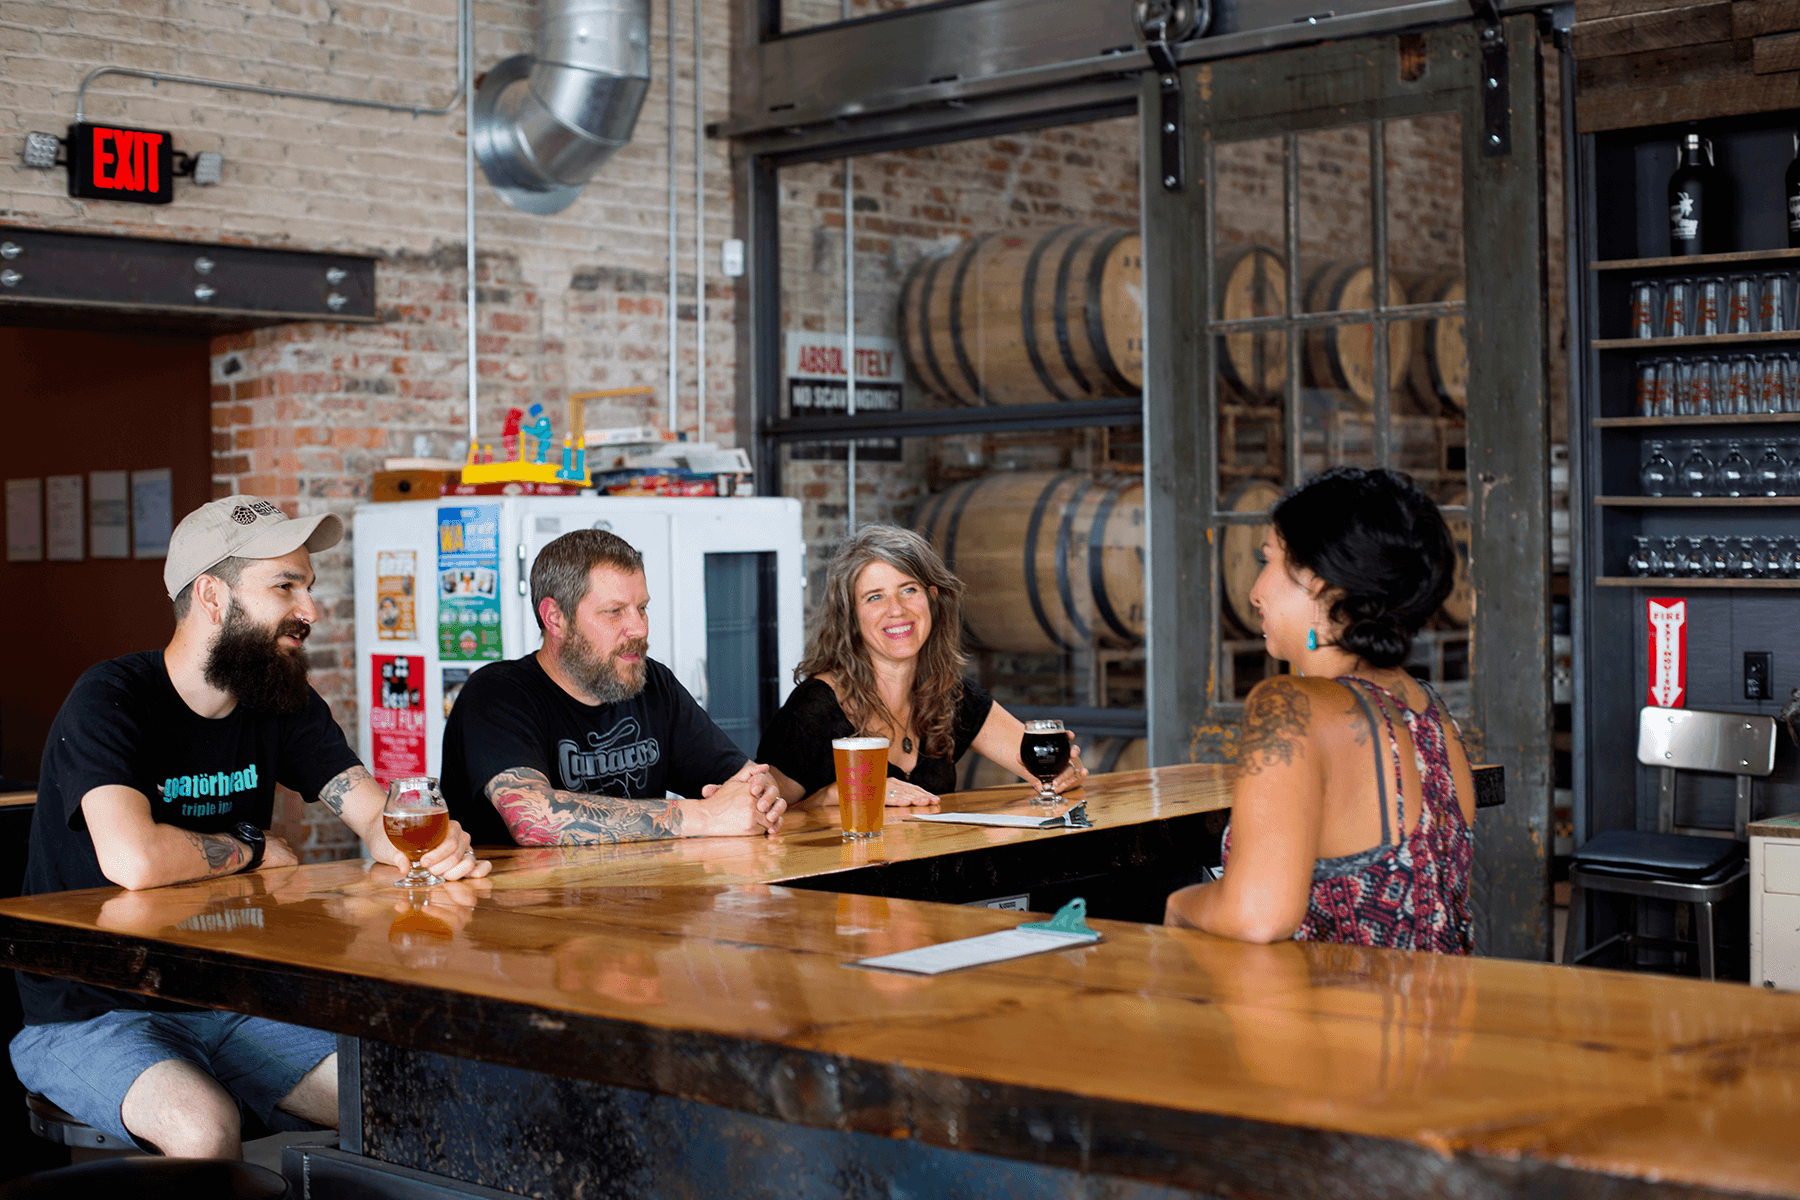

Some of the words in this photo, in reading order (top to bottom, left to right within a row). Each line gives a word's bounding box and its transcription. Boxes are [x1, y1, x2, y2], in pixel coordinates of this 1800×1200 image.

[93, 127, 163, 193] EXIT
[798, 345, 894, 377] ABSOLTELY
[792, 386, 813, 408] NO
[1653, 612, 1681, 620] FIRE
[182, 801, 216, 817] triple
